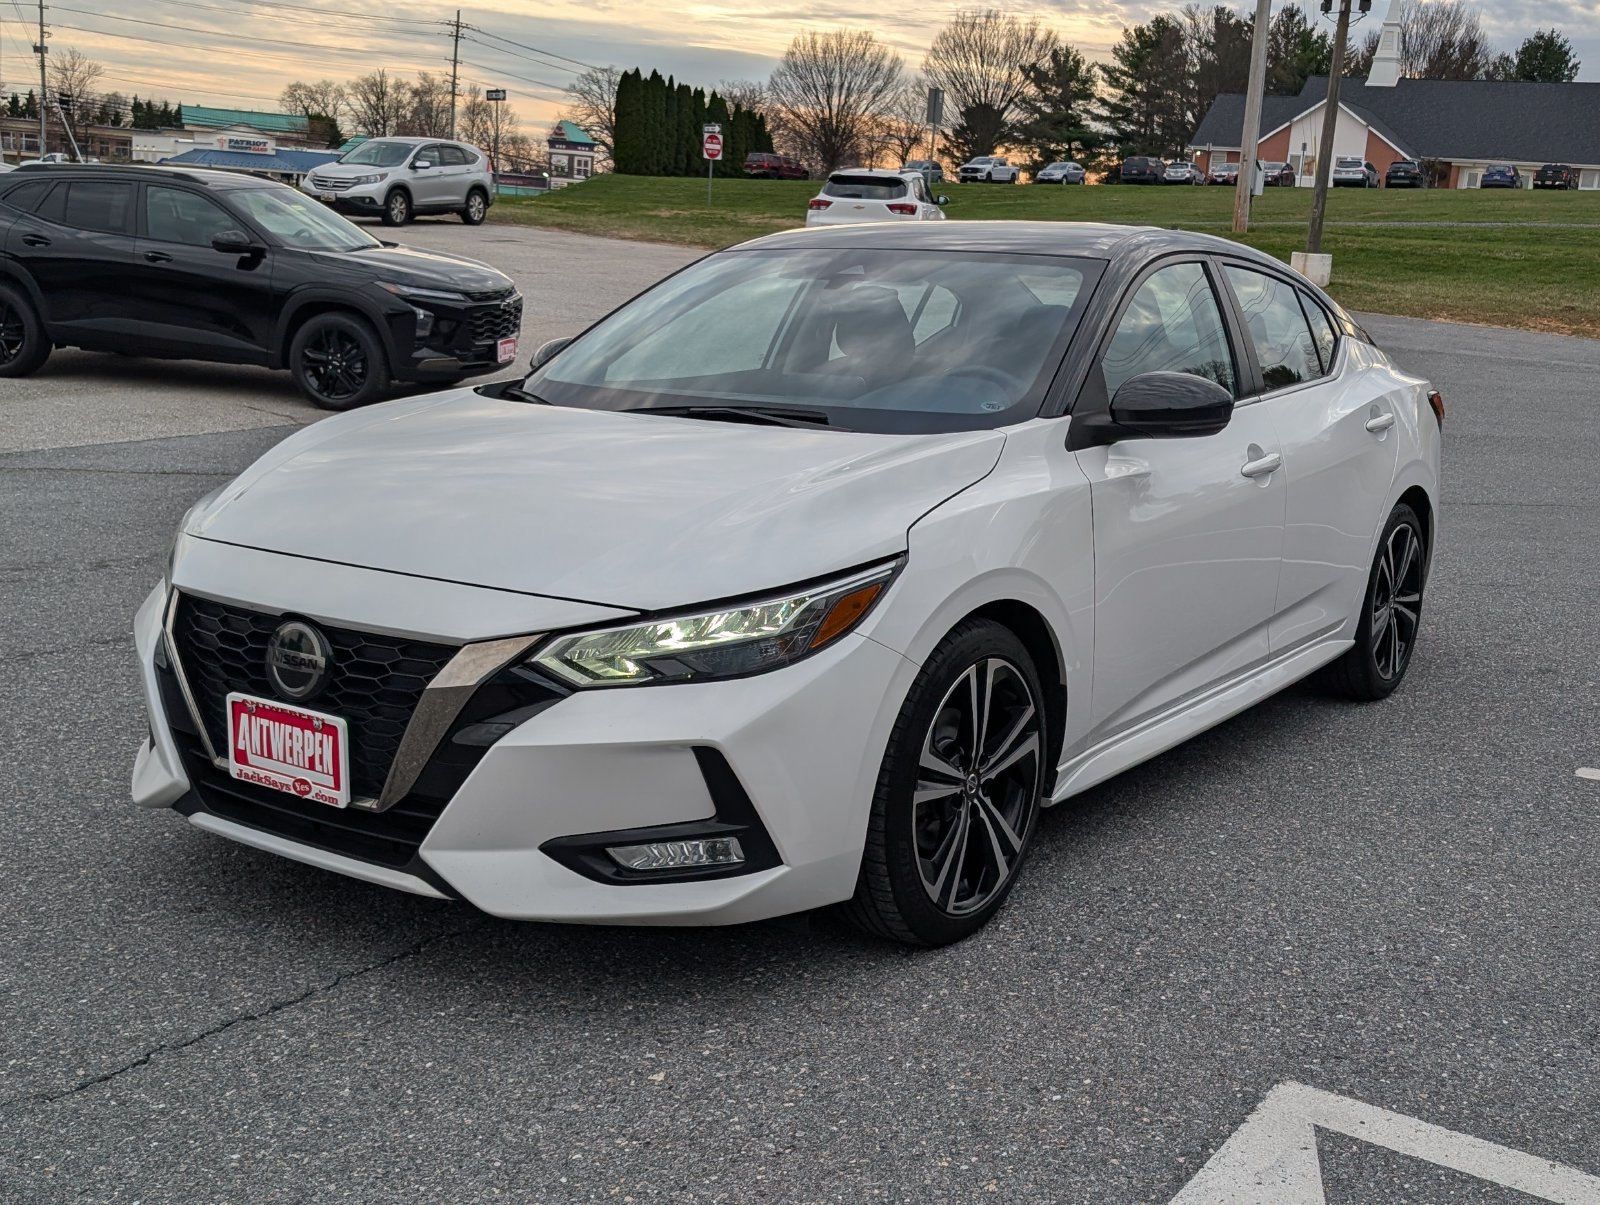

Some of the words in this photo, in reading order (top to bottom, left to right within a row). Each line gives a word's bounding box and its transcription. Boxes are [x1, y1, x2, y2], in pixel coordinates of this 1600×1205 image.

[228, 138, 268, 147] PATRIOT
[272, 651, 318, 670] NISSAN
[237, 712, 334, 776] ANTWERPEN
[236, 768, 292, 793] JackSays
[294, 781, 310, 793] Yes
[311, 790, 339, 806] .com
